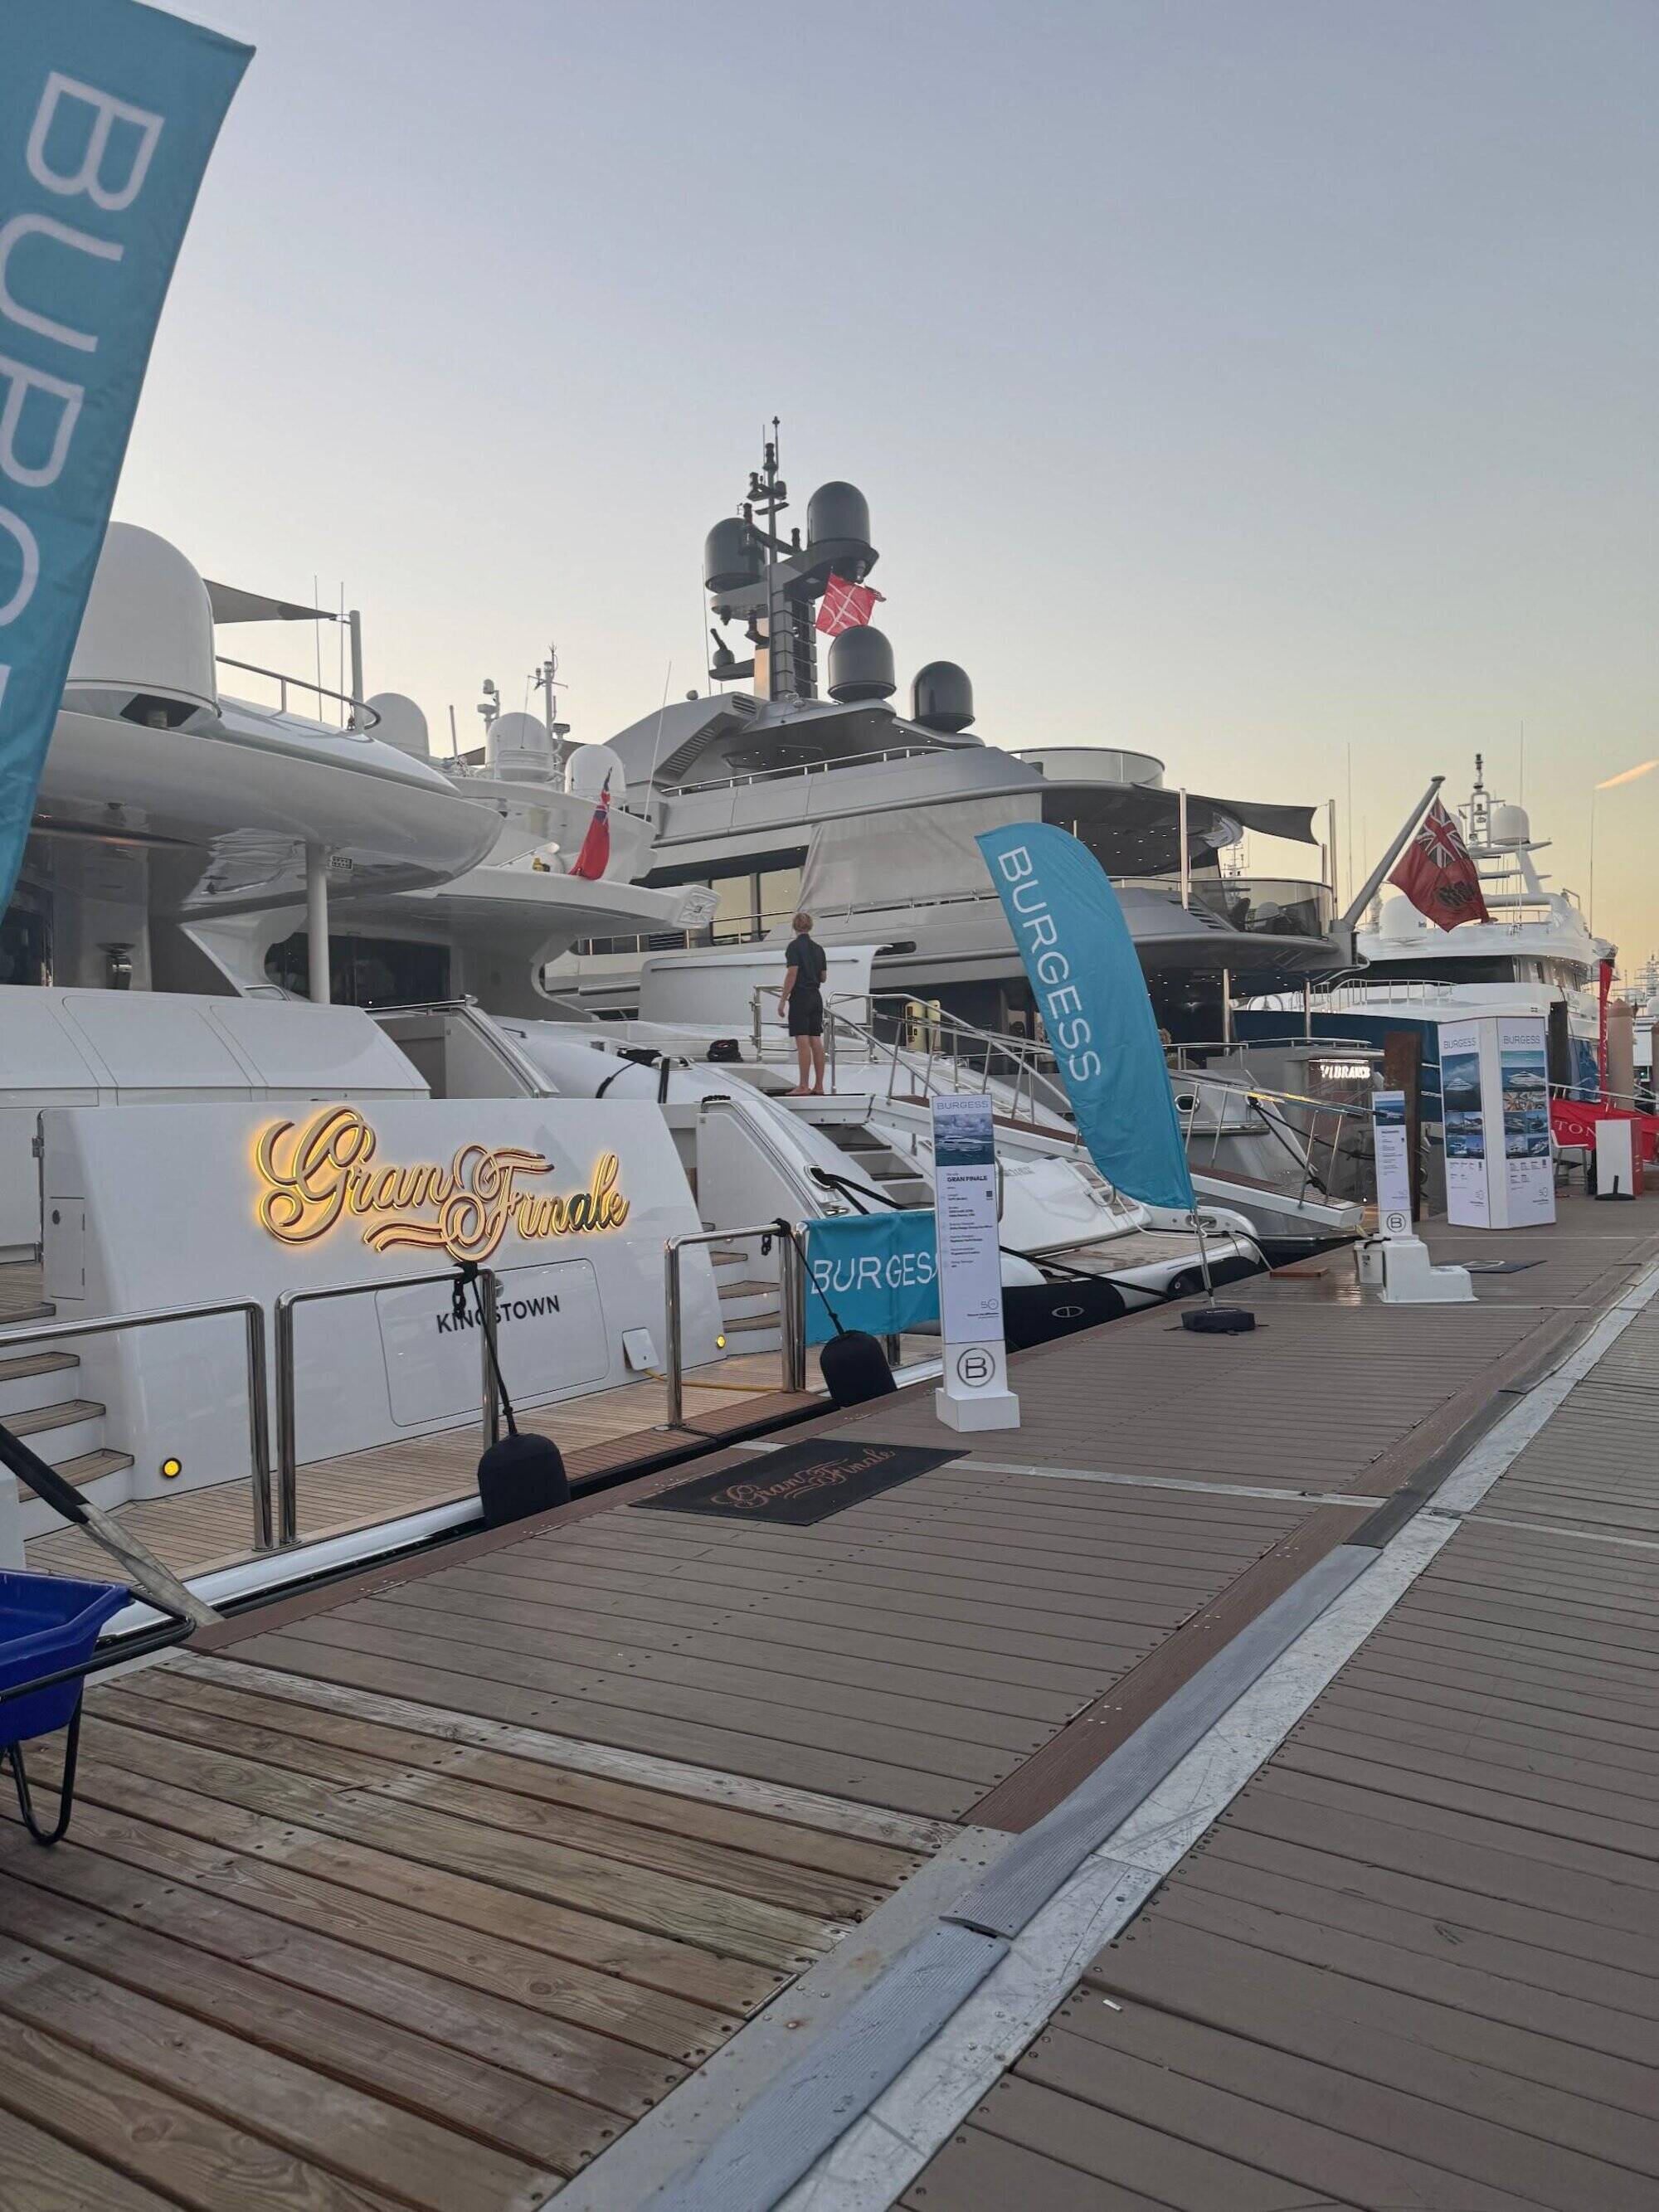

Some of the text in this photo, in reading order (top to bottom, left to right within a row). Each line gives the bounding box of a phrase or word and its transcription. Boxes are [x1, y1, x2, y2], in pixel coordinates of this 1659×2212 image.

[998, 845, 1101, 1082] BURGESS
[1503, 1035, 1541, 1045] BURGESS
[937, 1101, 989, 1110] BURGESS
[256, 1106, 630, 1262] Gran Finale
[1390, 1217, 1403, 1228] B
[810, 1251, 939, 1295] BURGES
[965, 1356, 988, 1378] B
